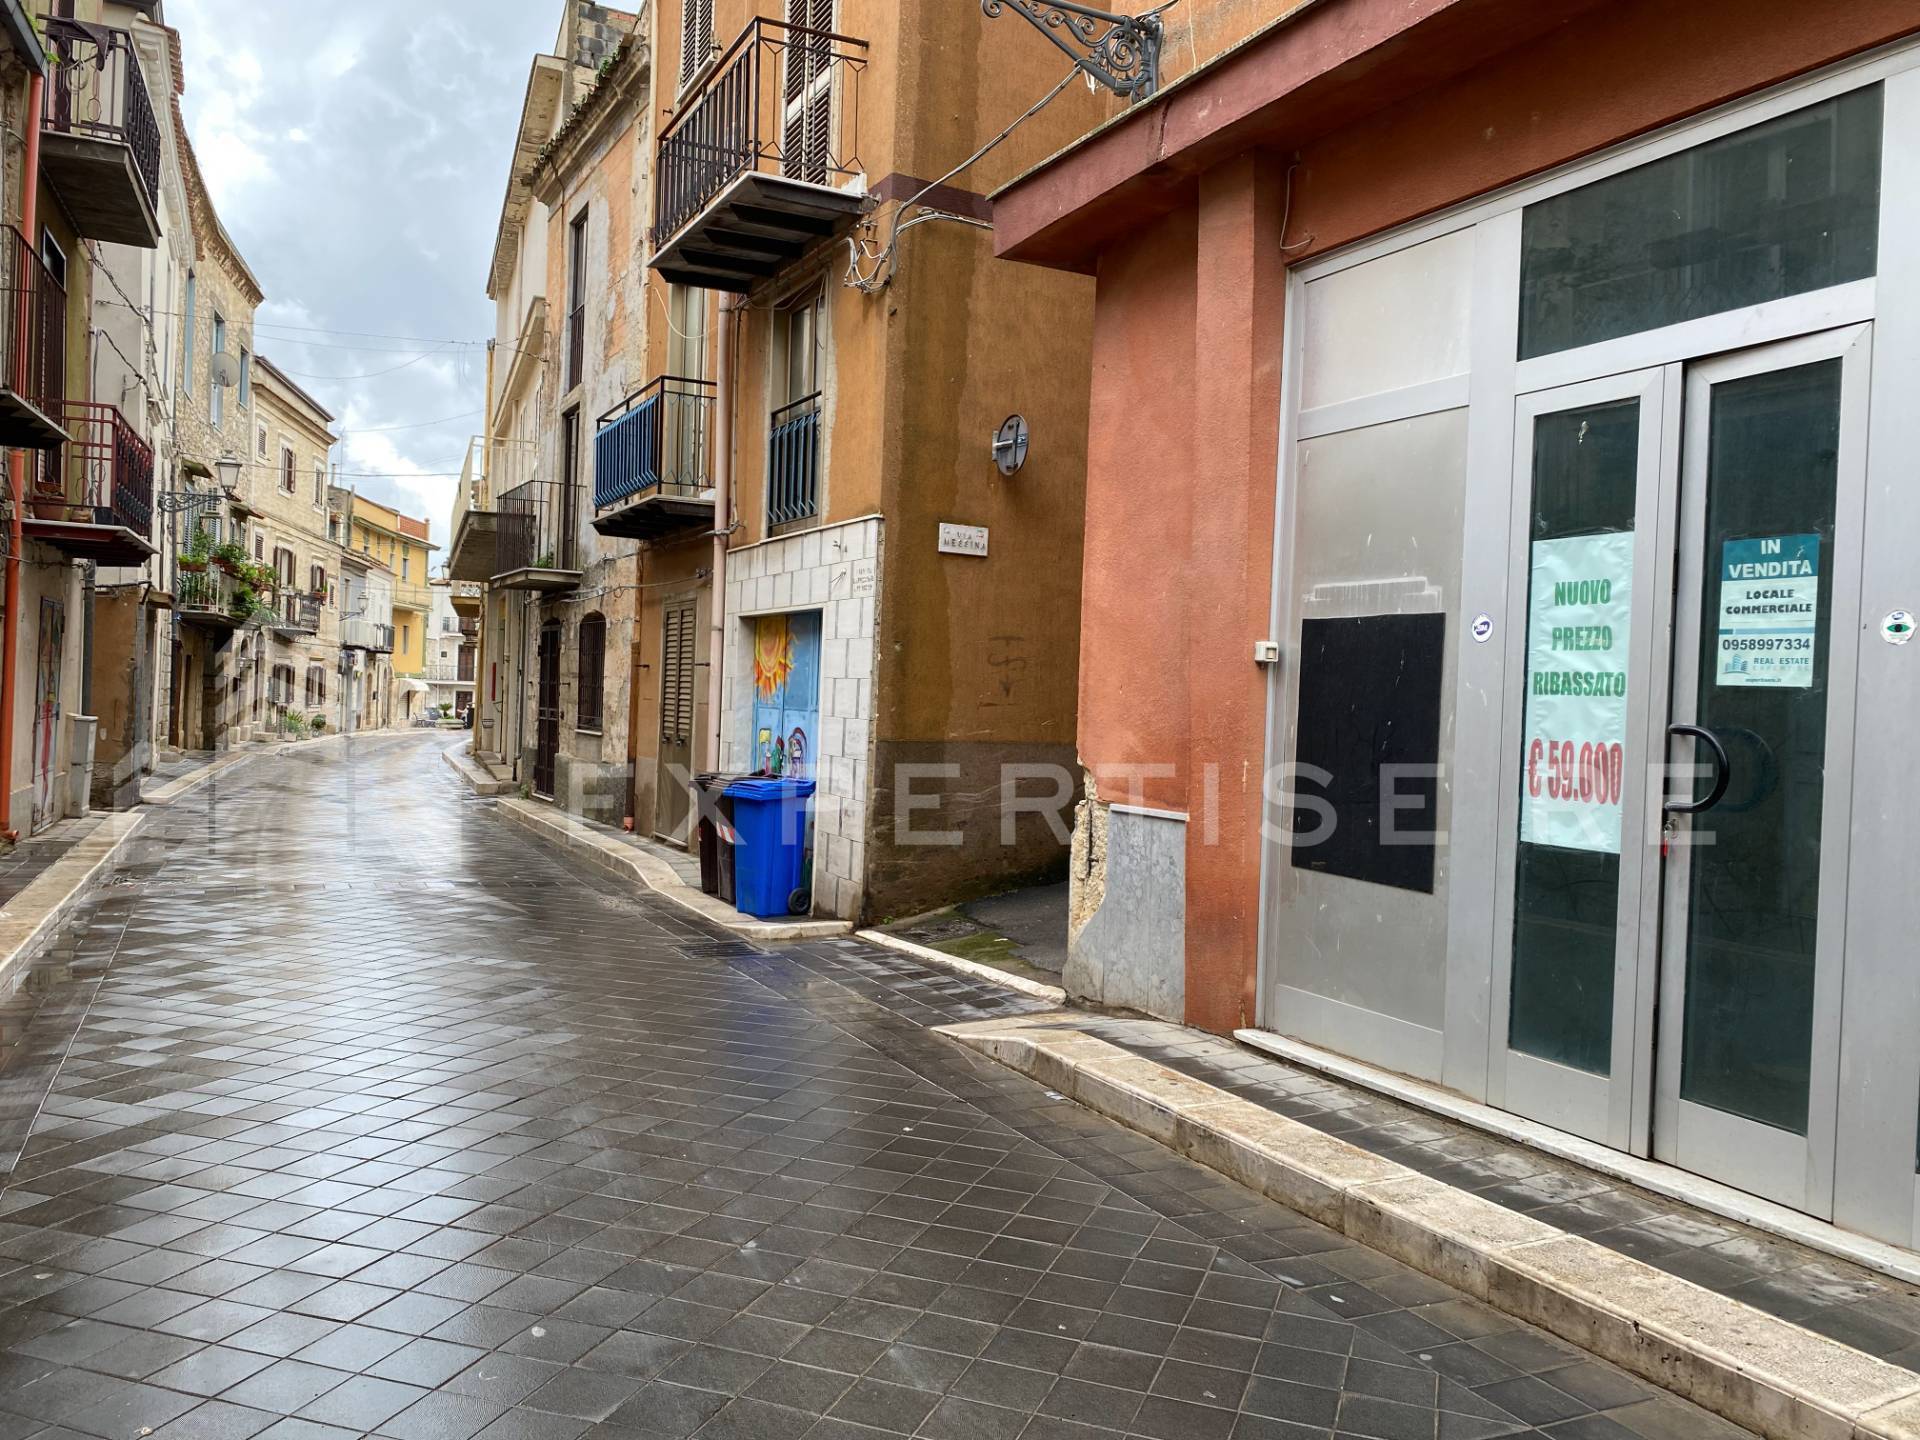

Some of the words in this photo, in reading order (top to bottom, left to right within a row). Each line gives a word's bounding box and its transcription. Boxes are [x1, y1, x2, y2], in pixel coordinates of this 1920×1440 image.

[957, 531, 972, 539] VIA
[943, 539, 986, 550] MESSINA
[1761, 539, 1781, 554] IN
[1728, 560, 1813, 578] VENDITA
[1554, 579, 1612, 606] NUOVO
[1746, 589, 1795, 600] LOCALE
[1725, 604, 1813, 615] COMMERCIALE
[1552, 626, 1613, 651] PREZZO
[1722, 638, 1811, 651] 0958997334
[1753, 657, 1775, 665] REAL
[1779, 657, 1809, 665] ESTATE
[1533, 671, 1627, 697] RIBASSATO
